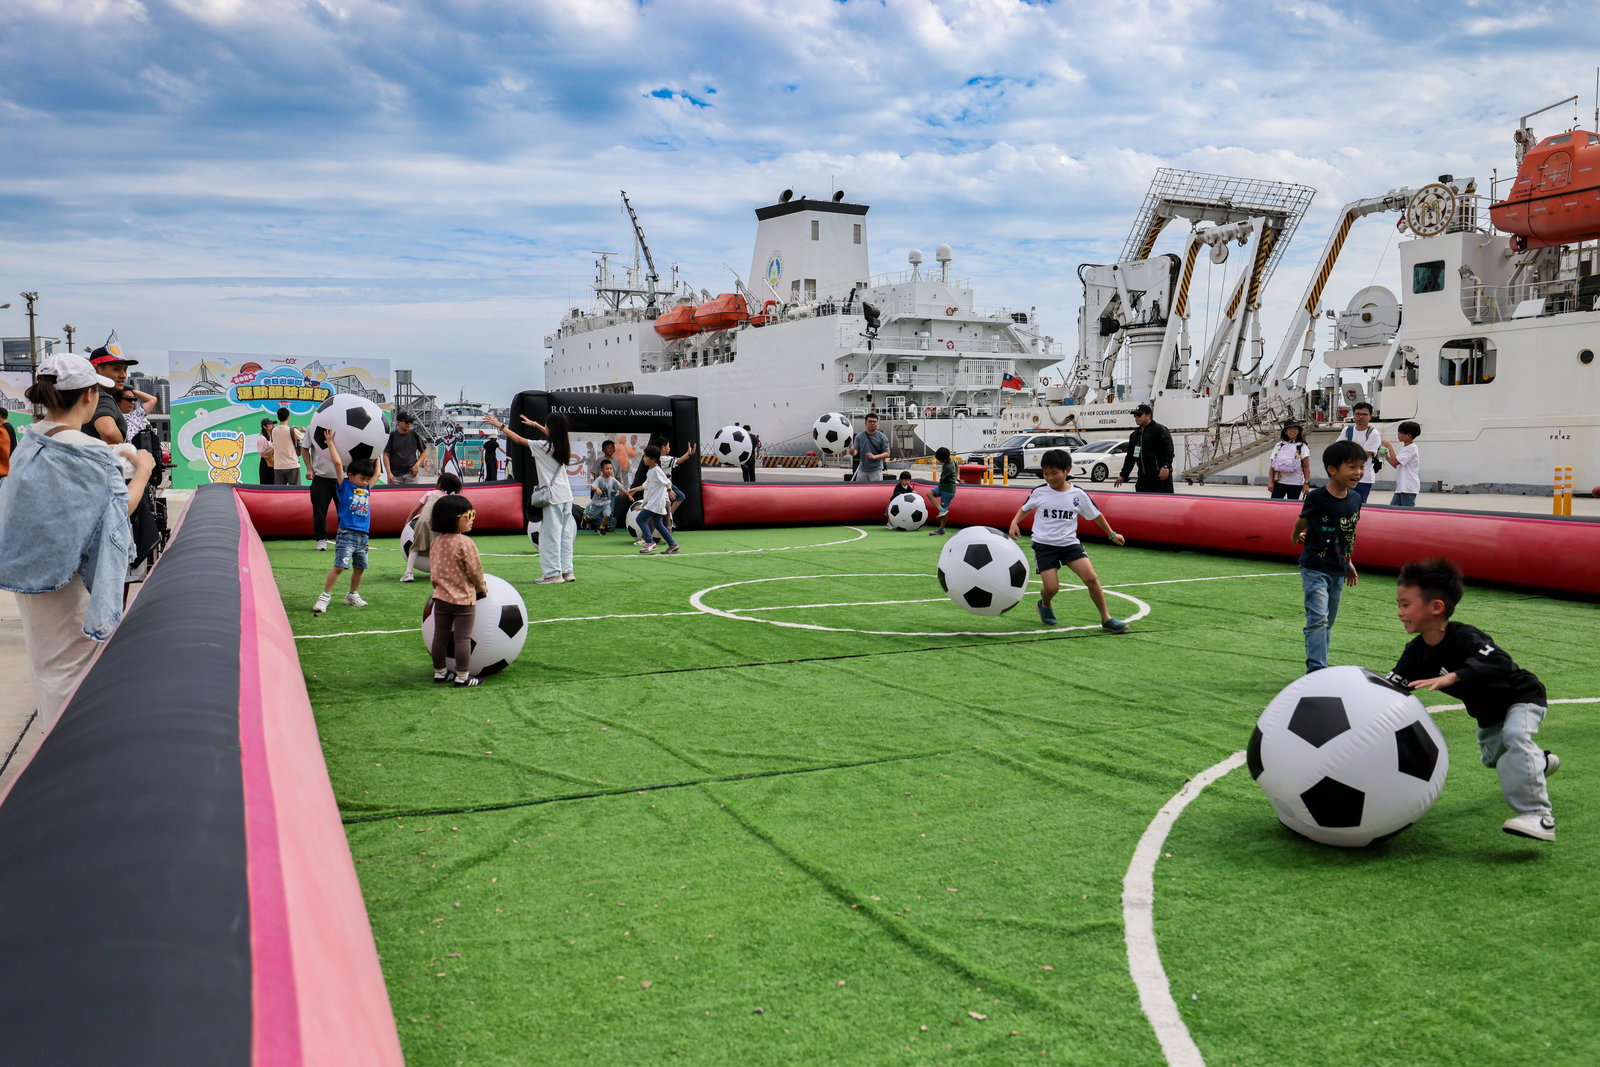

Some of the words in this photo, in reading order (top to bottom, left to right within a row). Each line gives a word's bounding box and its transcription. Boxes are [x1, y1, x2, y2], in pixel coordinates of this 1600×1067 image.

[551, 405, 576, 414] R.O.C.
[579, 406, 627, 416] Mini-Soccer
[628, 408, 673, 417] Association
[1043, 508, 1049, 518] A
[1051, 509, 1074, 520] STAR
